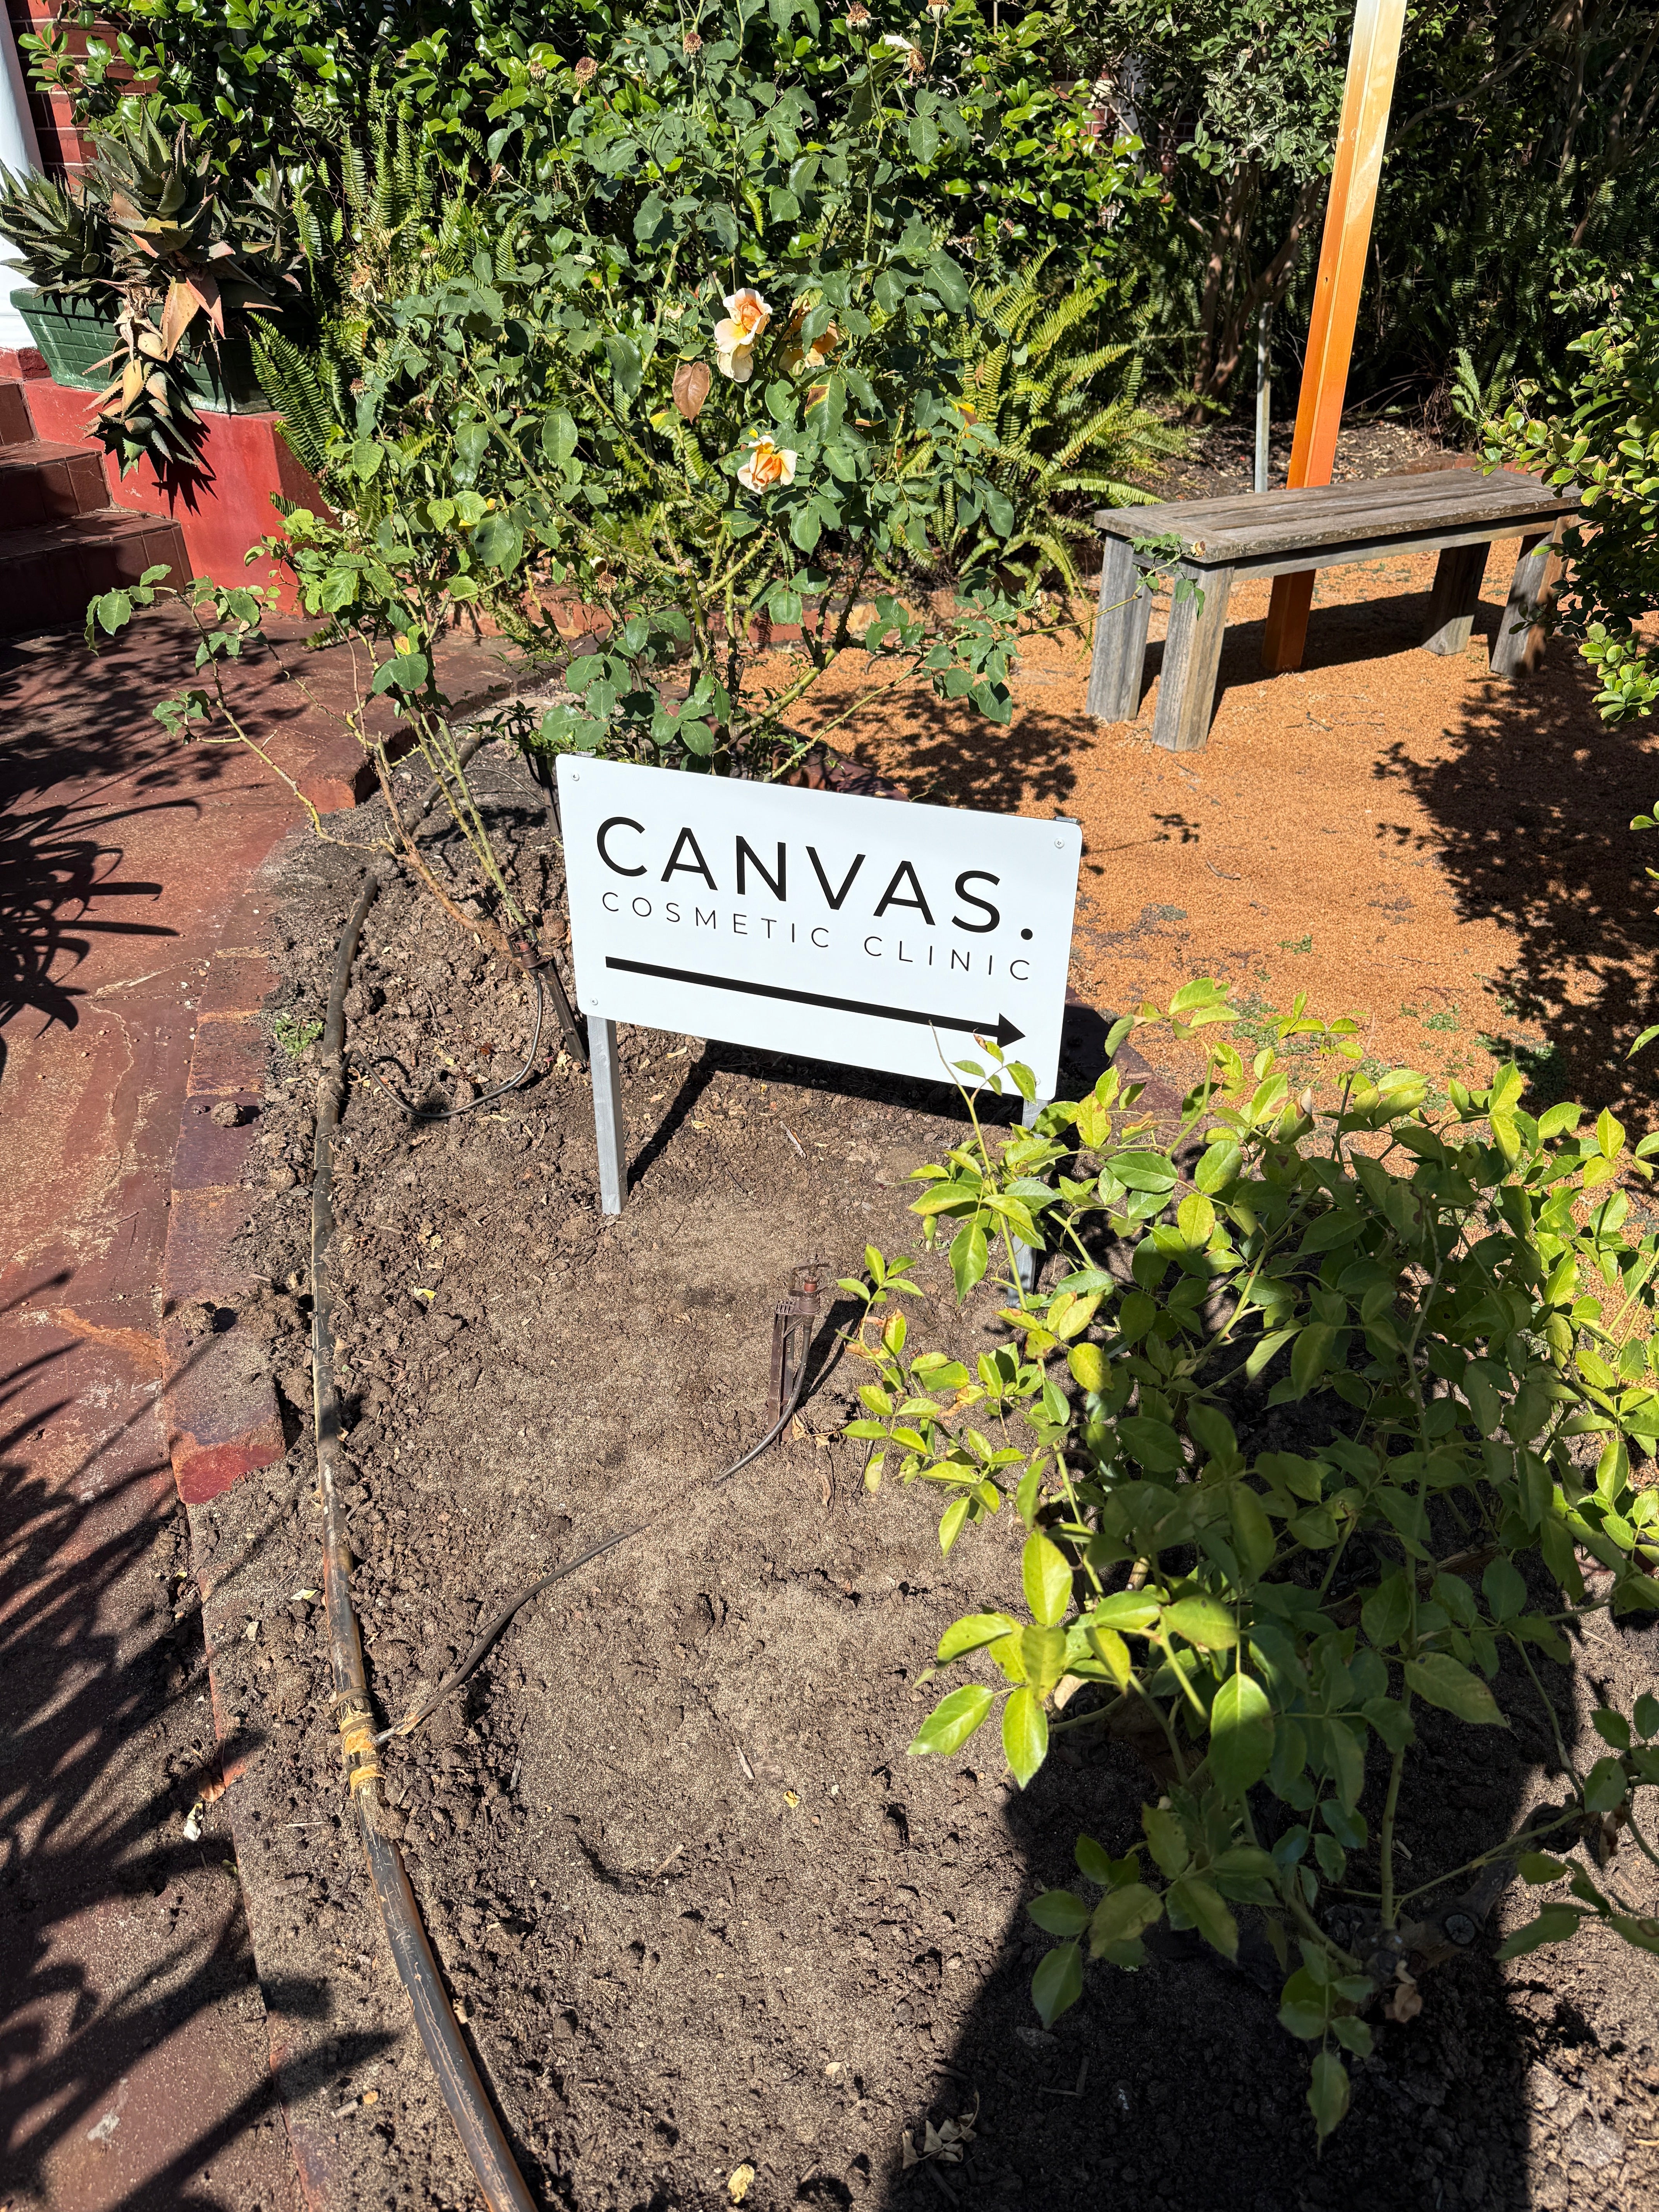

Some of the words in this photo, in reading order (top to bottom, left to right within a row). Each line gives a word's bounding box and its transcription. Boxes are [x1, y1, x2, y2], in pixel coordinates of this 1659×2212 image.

[597, 816, 1033, 940] CANVAS.
[602, 892, 829, 948] COSMETIC
[864, 936, 1030, 981] CLINIC
